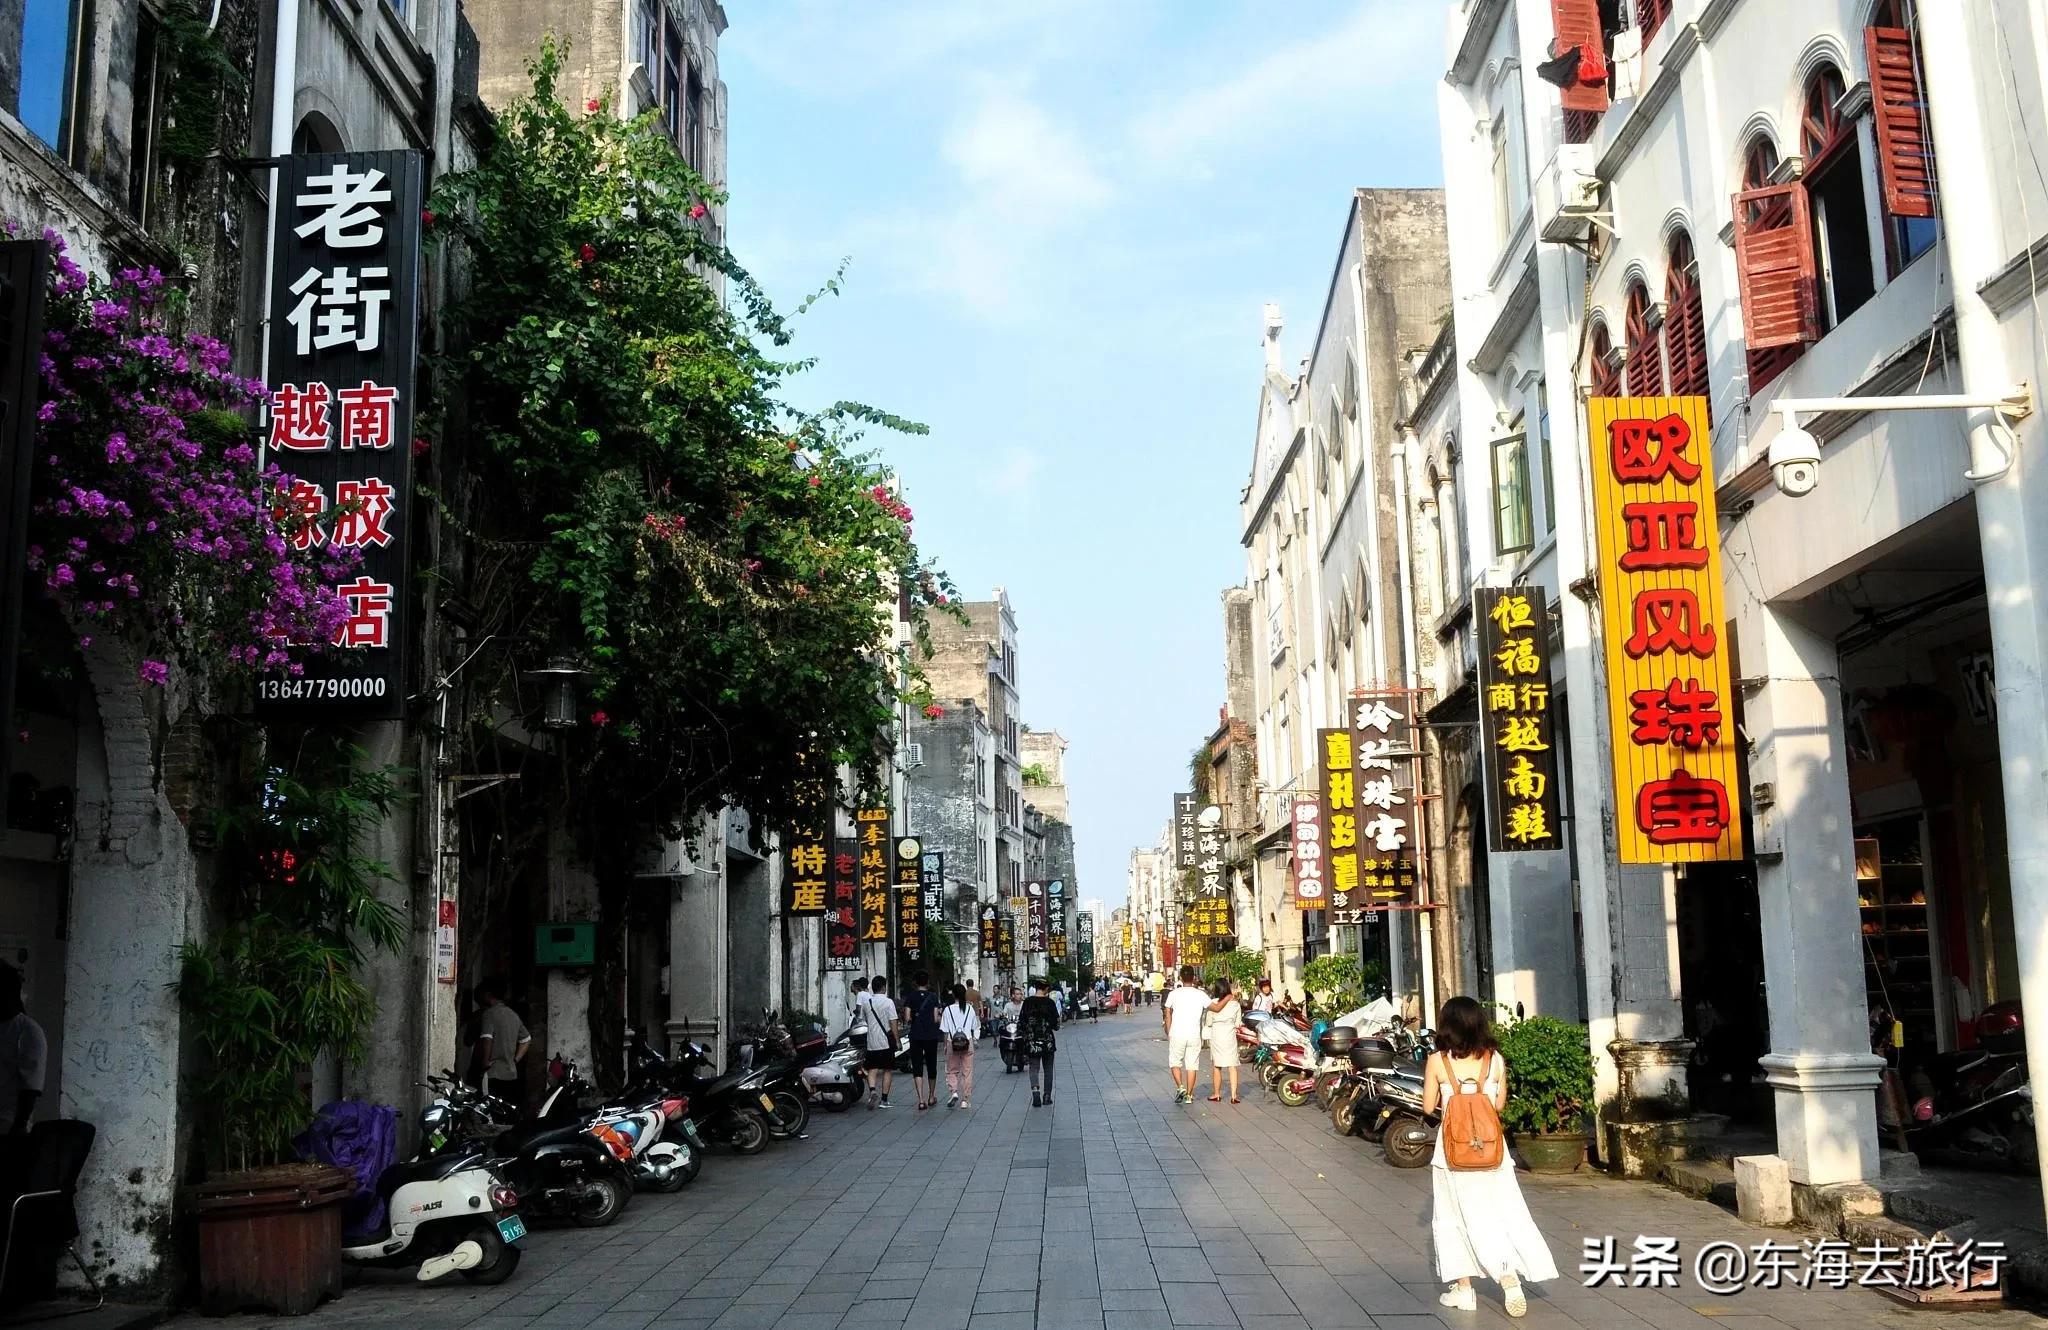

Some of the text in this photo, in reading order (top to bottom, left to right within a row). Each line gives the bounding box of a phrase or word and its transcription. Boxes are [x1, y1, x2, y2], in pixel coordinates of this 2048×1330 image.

[286, 164, 391, 355] 老街
[269, 381, 399, 450] 越南
[1491, 595, 1541, 677] 恒福
[1607, 413, 1729, 846] 欧亚风珠宝
[259, 677, 386, 699] 13647790000
[1488, 683, 1549, 713] 商行
[1496, 716, 1553, 844] 越南鞋
[1180, 796, 1196, 865] 十元珍珠店
[860, 824, 887, 939] 李姨虾饼店
[1198, 899, 1228, 911] 工艺品
